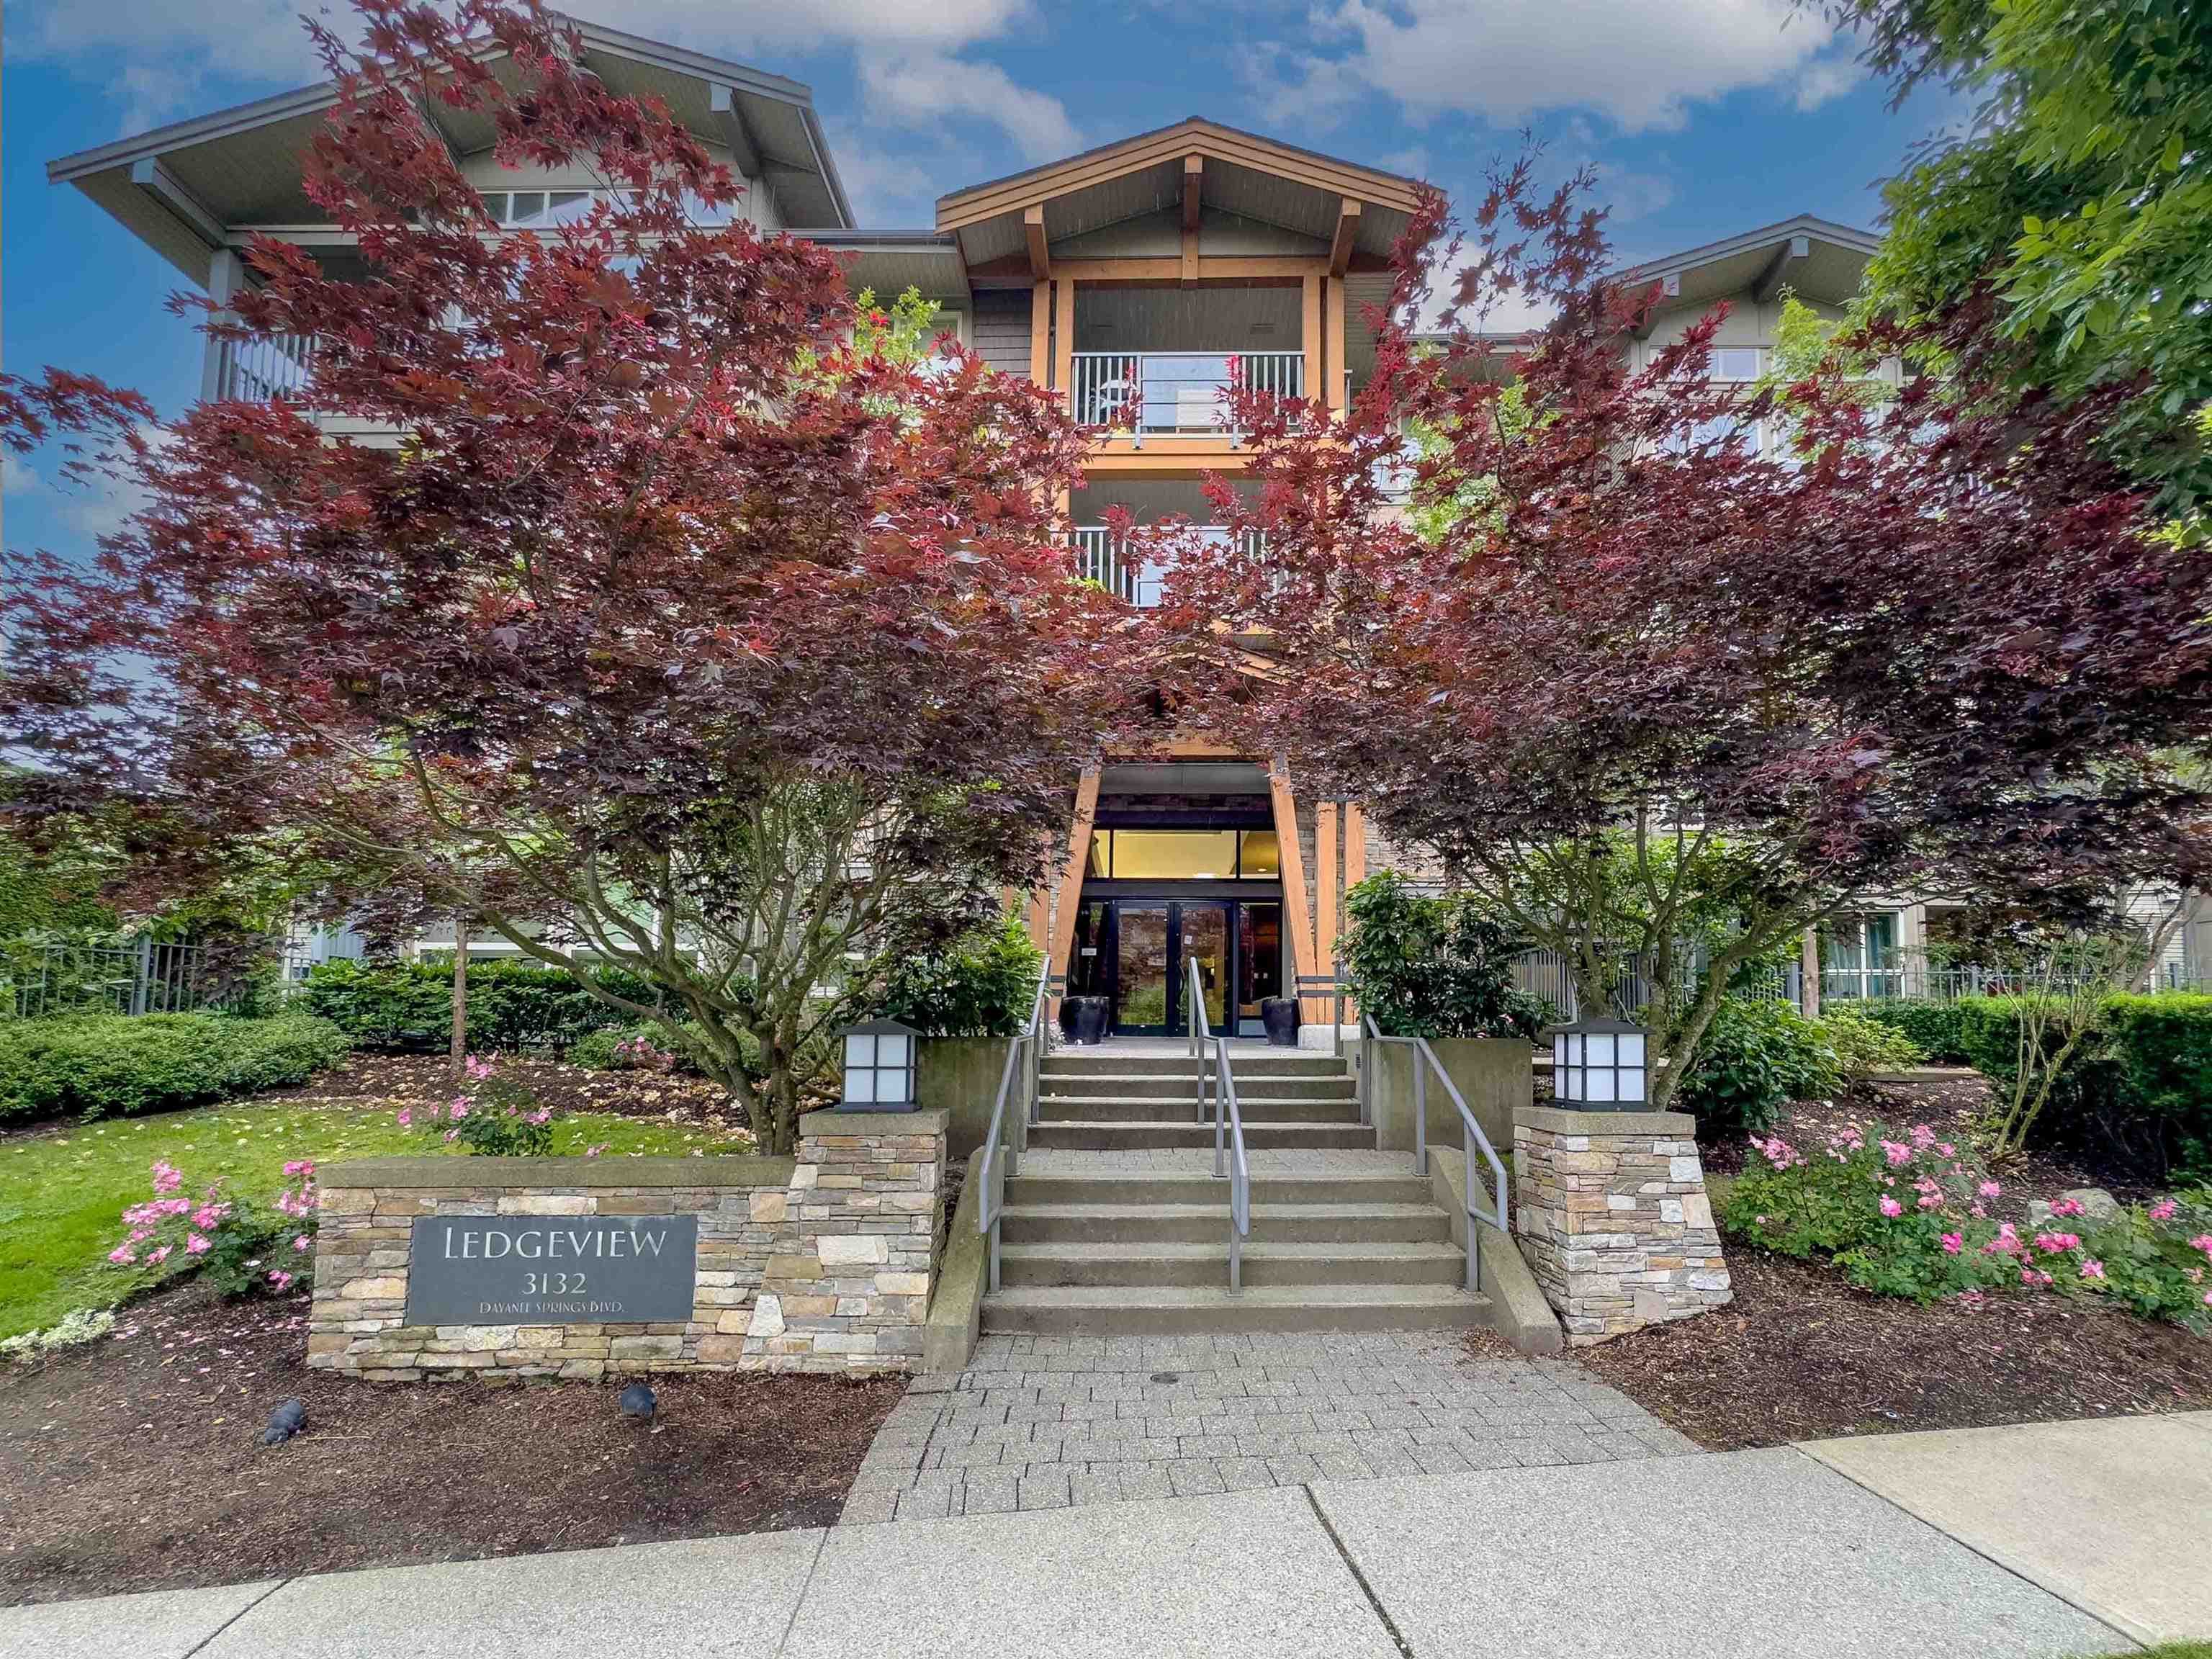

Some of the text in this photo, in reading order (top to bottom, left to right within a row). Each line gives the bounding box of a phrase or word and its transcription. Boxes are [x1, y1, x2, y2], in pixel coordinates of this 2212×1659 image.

[444, 1227, 667, 1259] LEDGEVIEW
[521, 1272, 587, 1295] 3132
[535, 1301, 588, 1314] SPRINGS
